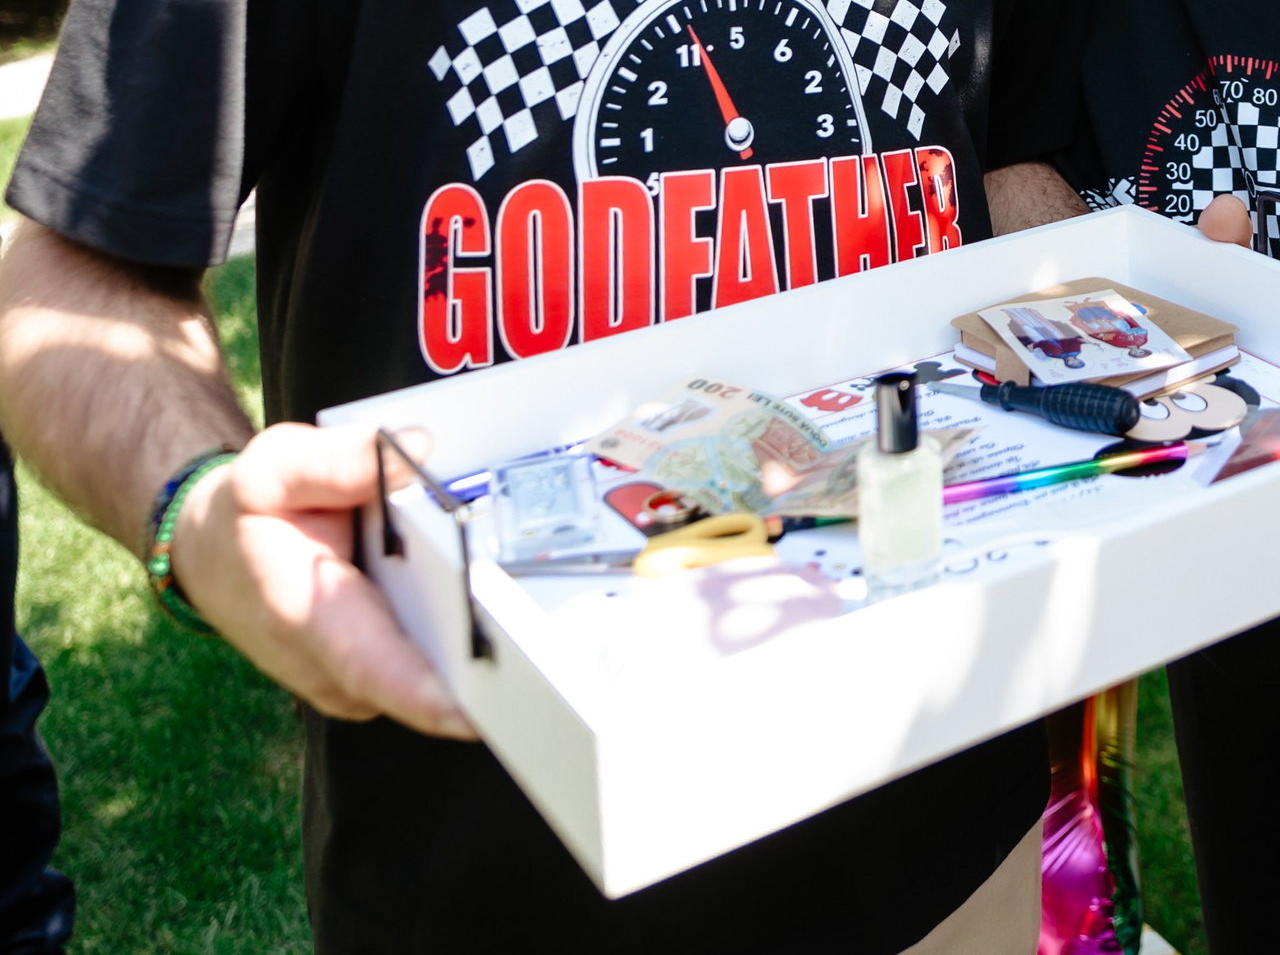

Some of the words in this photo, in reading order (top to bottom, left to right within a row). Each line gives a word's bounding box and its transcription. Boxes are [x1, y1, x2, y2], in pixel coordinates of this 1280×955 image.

[729, 26, 745, 49] 5
[773, 39, 794, 63] 6
[647, 80, 668, 106] 2
[804, 70, 823, 94] 2
[1219, 80, 1244, 99] 70
[1252, 87, 1278, 106] 80
[815, 113, 835, 138] 3
[1194, 109, 1217, 128] 50
[639, 128, 654, 152] 1
[1174, 133, 1200, 152] 40
[1165, 162, 1191, 180] 30
[1164, 194, 1191, 213] 20
[418, 145, 962, 374] GODFATHER
[686, 378, 745, 400] 200
